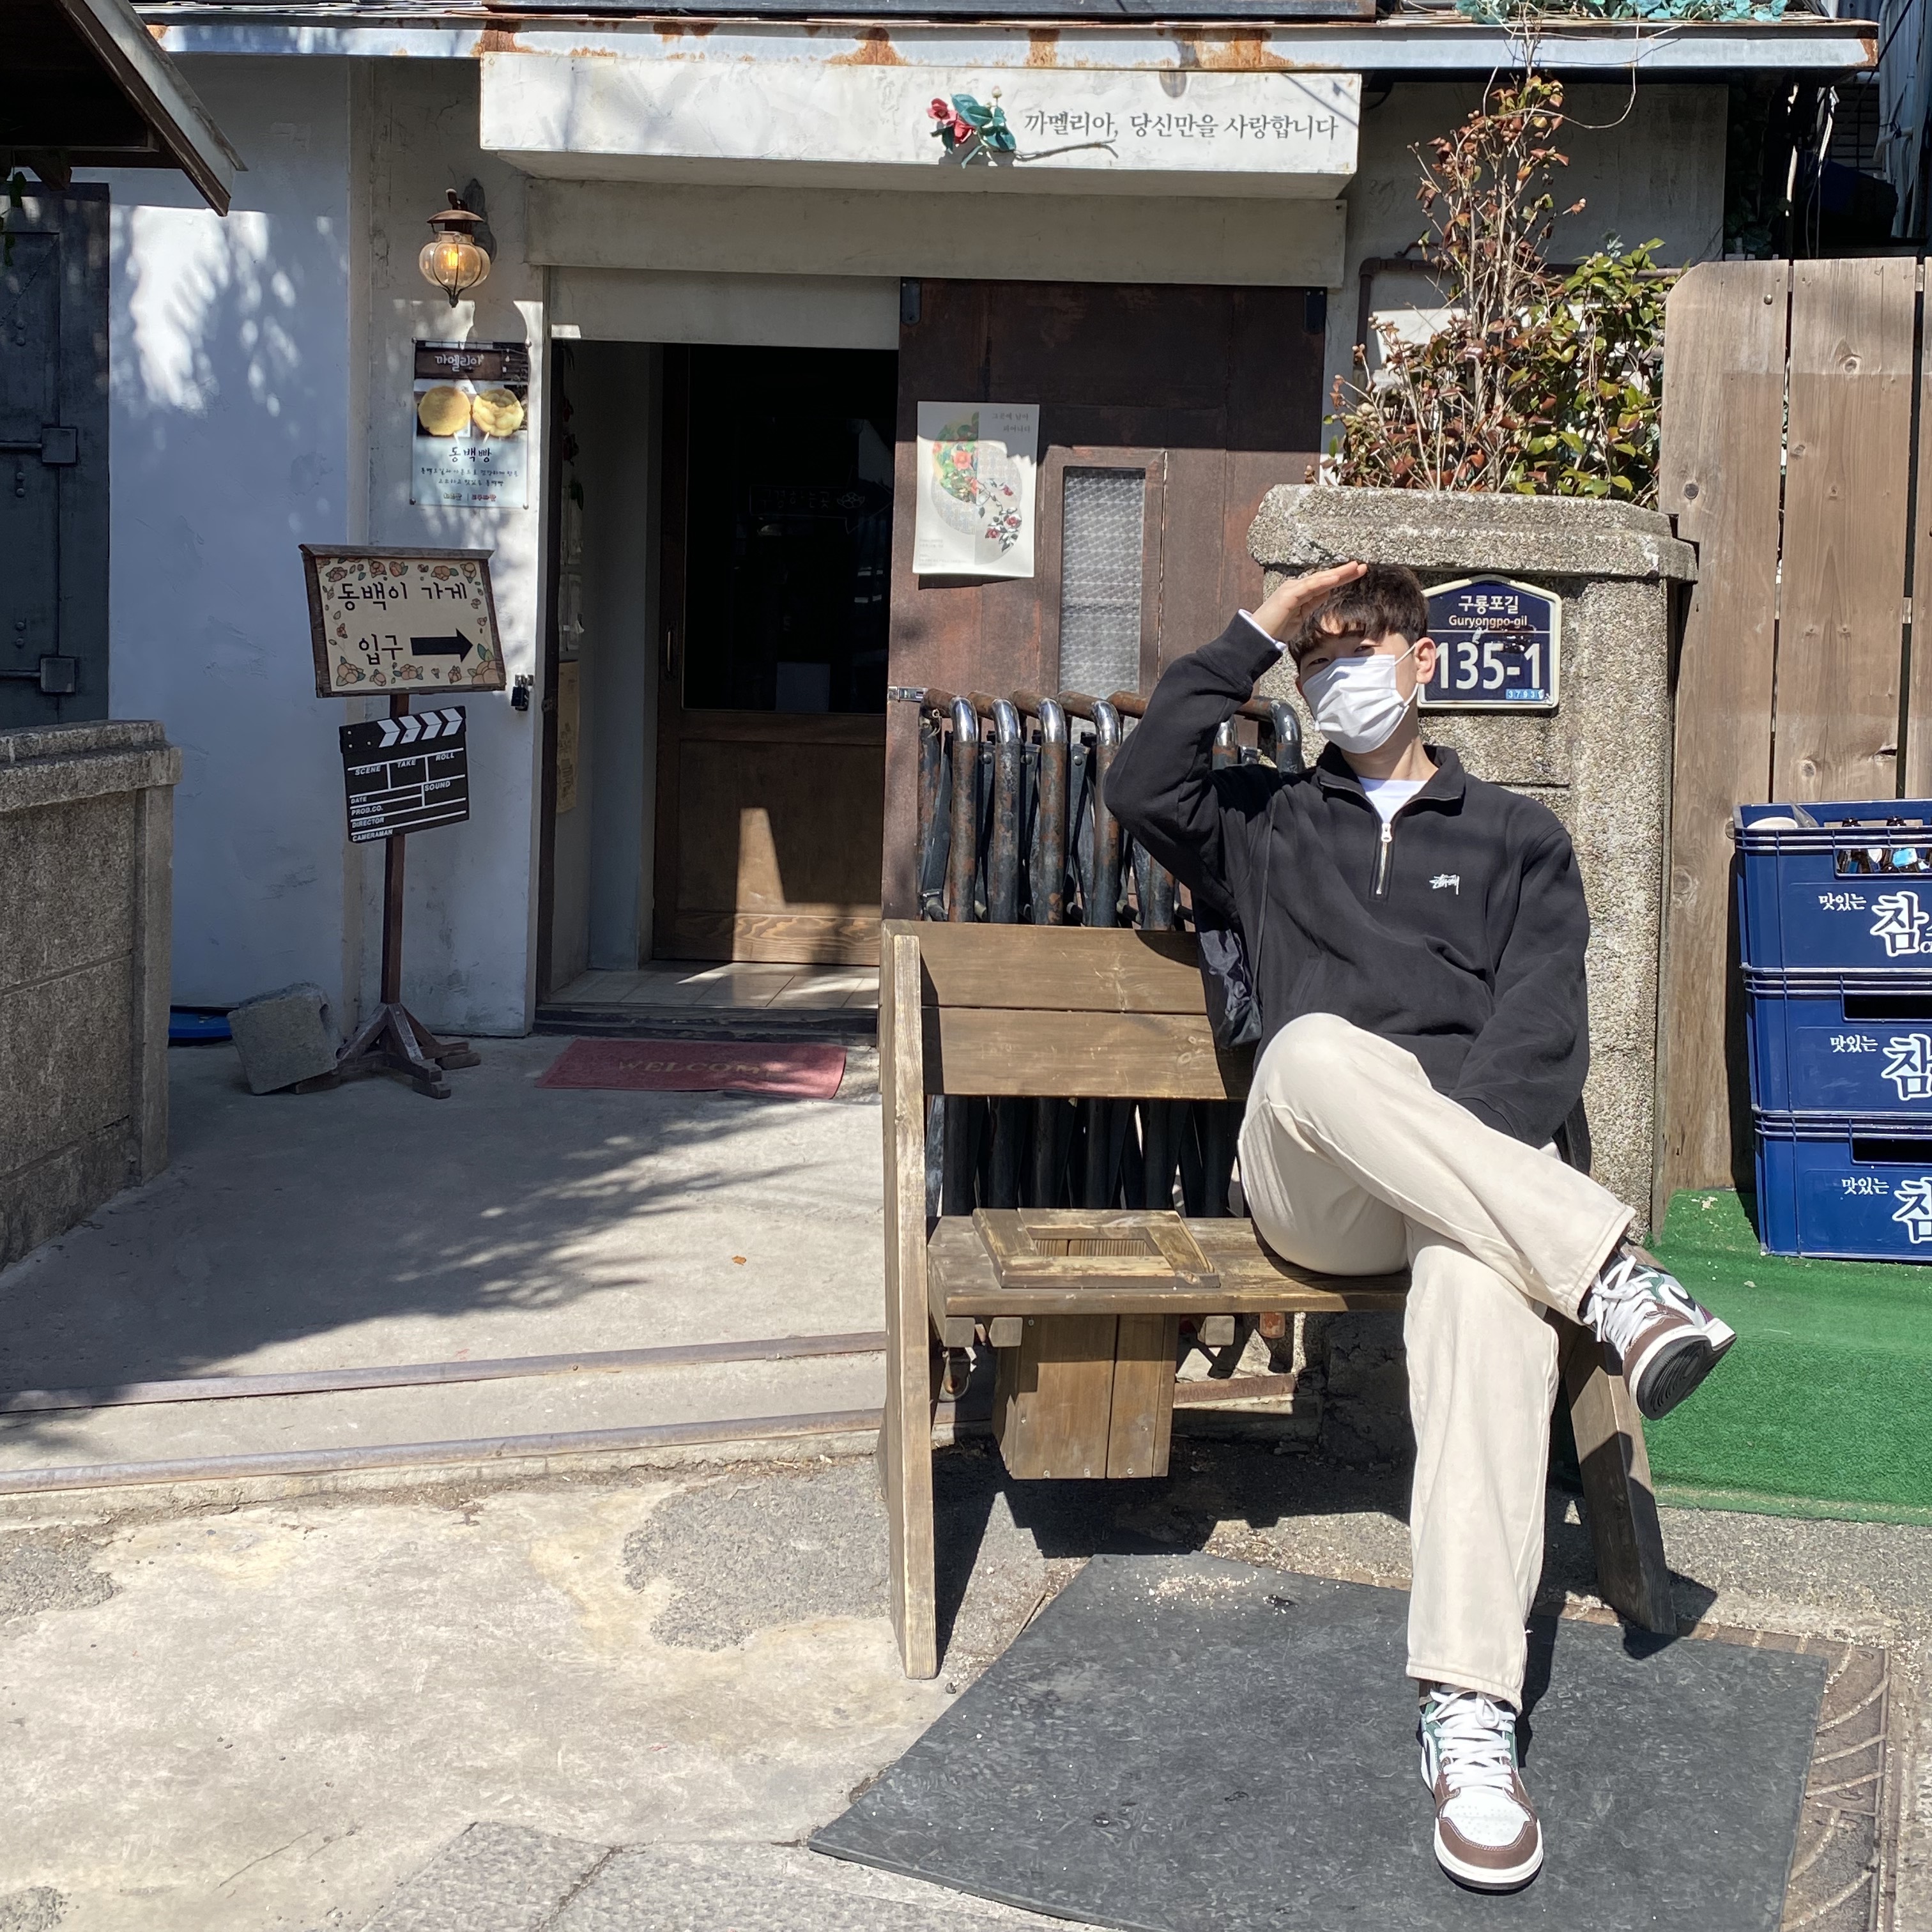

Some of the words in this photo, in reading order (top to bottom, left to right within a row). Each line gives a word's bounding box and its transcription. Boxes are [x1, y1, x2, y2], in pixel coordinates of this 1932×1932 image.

[1024, 110, 1118, 137] 까멜리아,
[1130, 112, 1219, 138] 당신만을
[1223, 114, 1339, 140] 사랑합니다
[337, 582, 408, 611] 동백이
[421, 582, 468, 599] 가게
[1458, 595, 1519, 615] 구룡포길
[1449, 615, 1528, 628] Guryongpo-gil
[358, 634, 403, 665] 입구
[1436, 642, 1540, 689] 135-1
[397, 759, 416, 768] TAKE
[435, 752, 455, 761] ROLL
[355, 765, 381, 776] SCENE
[424, 781, 451, 792] SOUND
[352, 817, 385, 828] DIRECTOR
[352, 829, 394, 841] CAMERAMAN
[1818, 892, 1867, 911] 맛있는
[619, 1061, 785, 1075] WELCOM
[1830, 1034, 1878, 1053] 맛있는
[1881, 1033, 1932, 1101] 참
[1841, 1177, 1890, 1195] 맛있는
